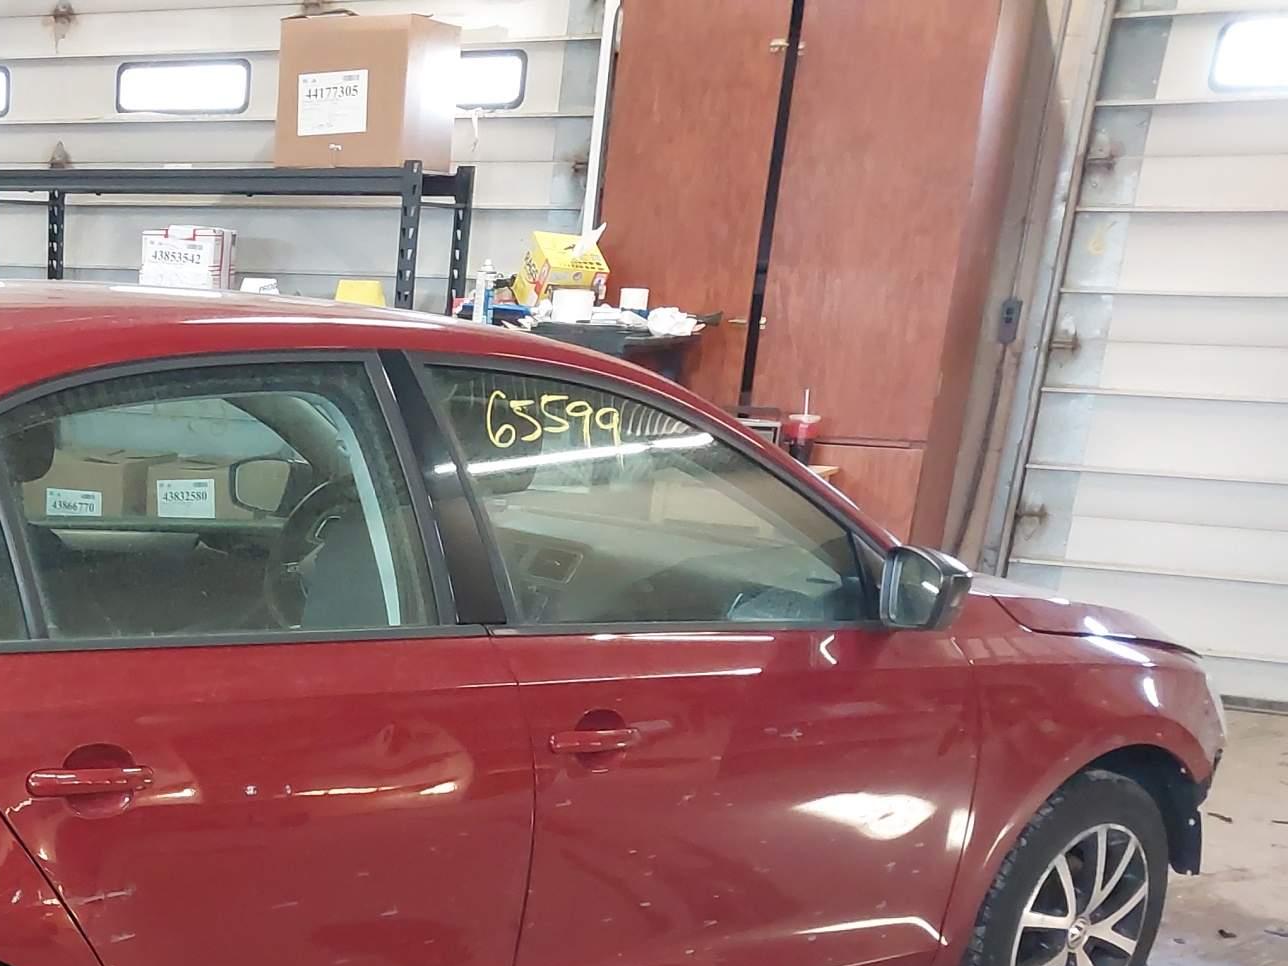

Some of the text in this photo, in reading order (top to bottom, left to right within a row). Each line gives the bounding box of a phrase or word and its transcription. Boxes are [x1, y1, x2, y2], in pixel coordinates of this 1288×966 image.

[304, 85, 359, 99] 44177305
[151, 250, 201, 265] 43853542
[486, 390, 622, 449] 65599
[162, 490, 208, 502] 43832580
